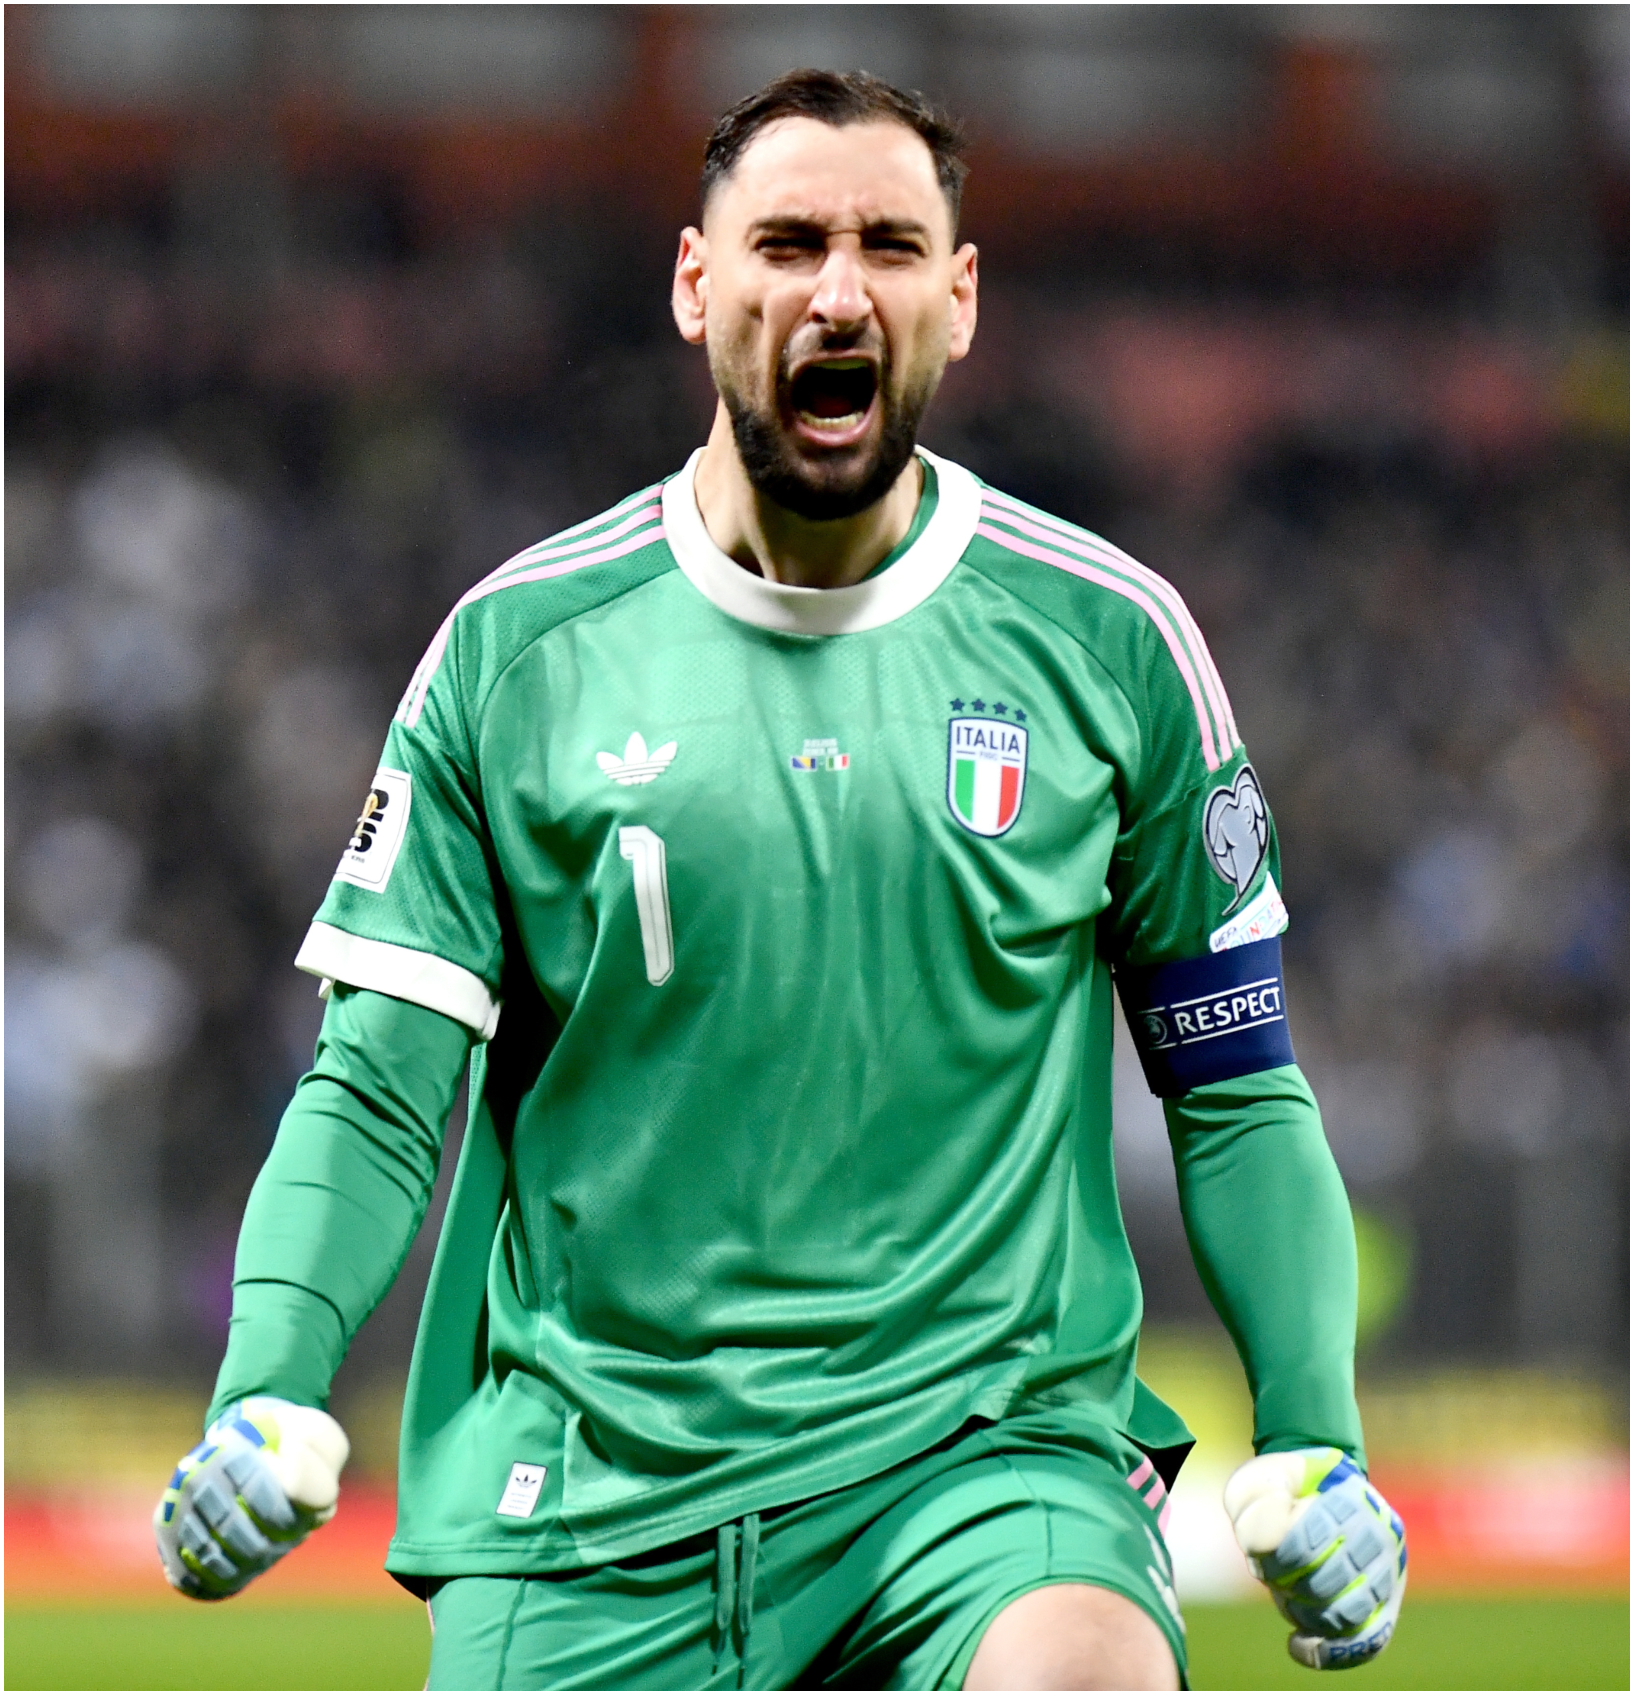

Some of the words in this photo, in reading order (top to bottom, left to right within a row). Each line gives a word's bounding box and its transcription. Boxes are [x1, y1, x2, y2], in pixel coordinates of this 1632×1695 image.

[956, 726, 1021, 754] ITALIA
[618, 825, 675, 987] 1
[1174, 986, 1281, 1036] RESPECT
